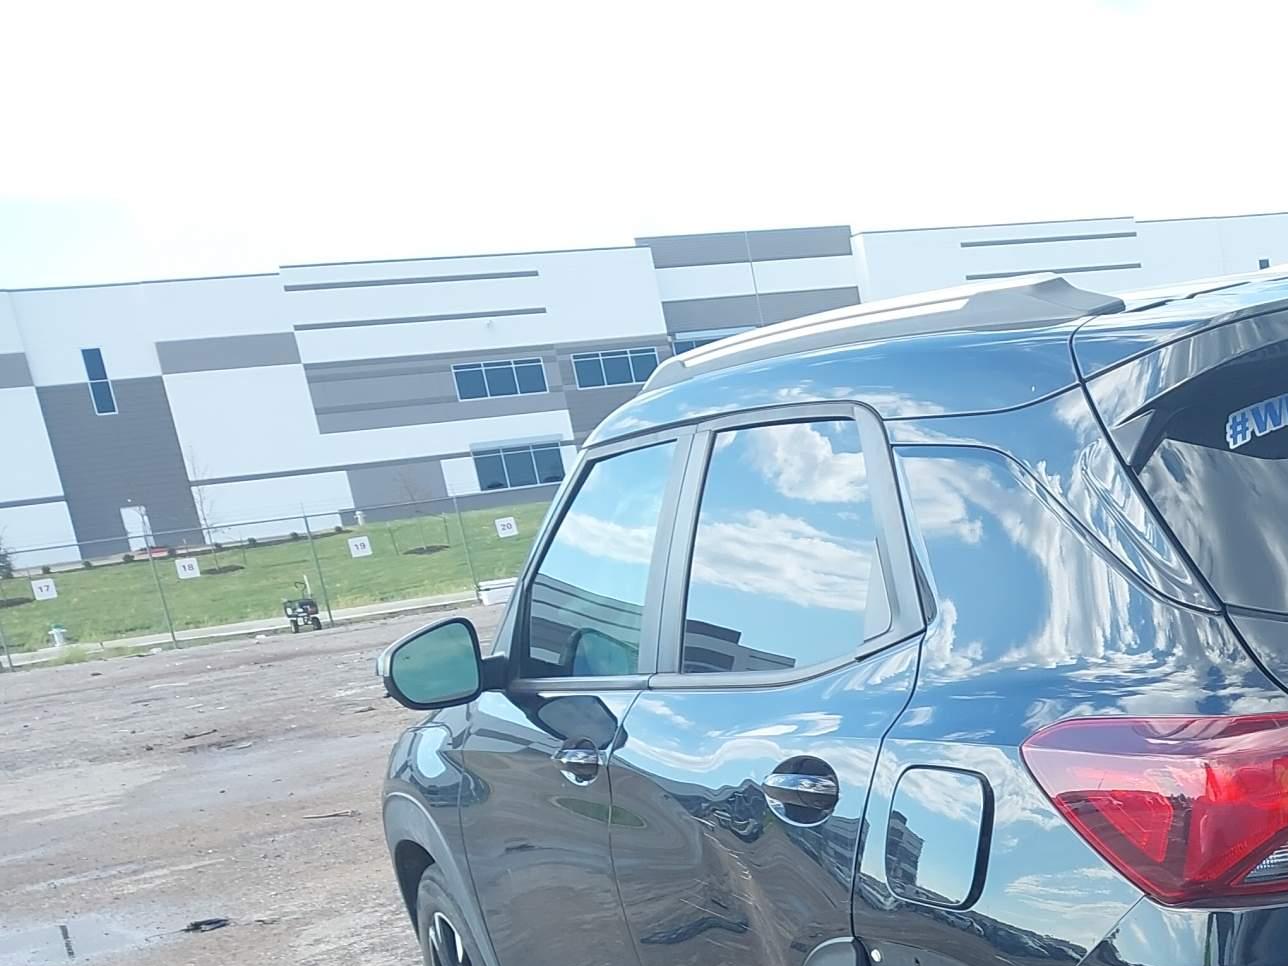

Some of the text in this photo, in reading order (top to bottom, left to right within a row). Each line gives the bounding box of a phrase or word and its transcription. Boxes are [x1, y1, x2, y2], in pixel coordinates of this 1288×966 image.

[500, 523, 513, 531] 20
[353, 542, 366, 551] 19
[181, 563, 194, 572] 18
[37, 584, 50, 593] 17
